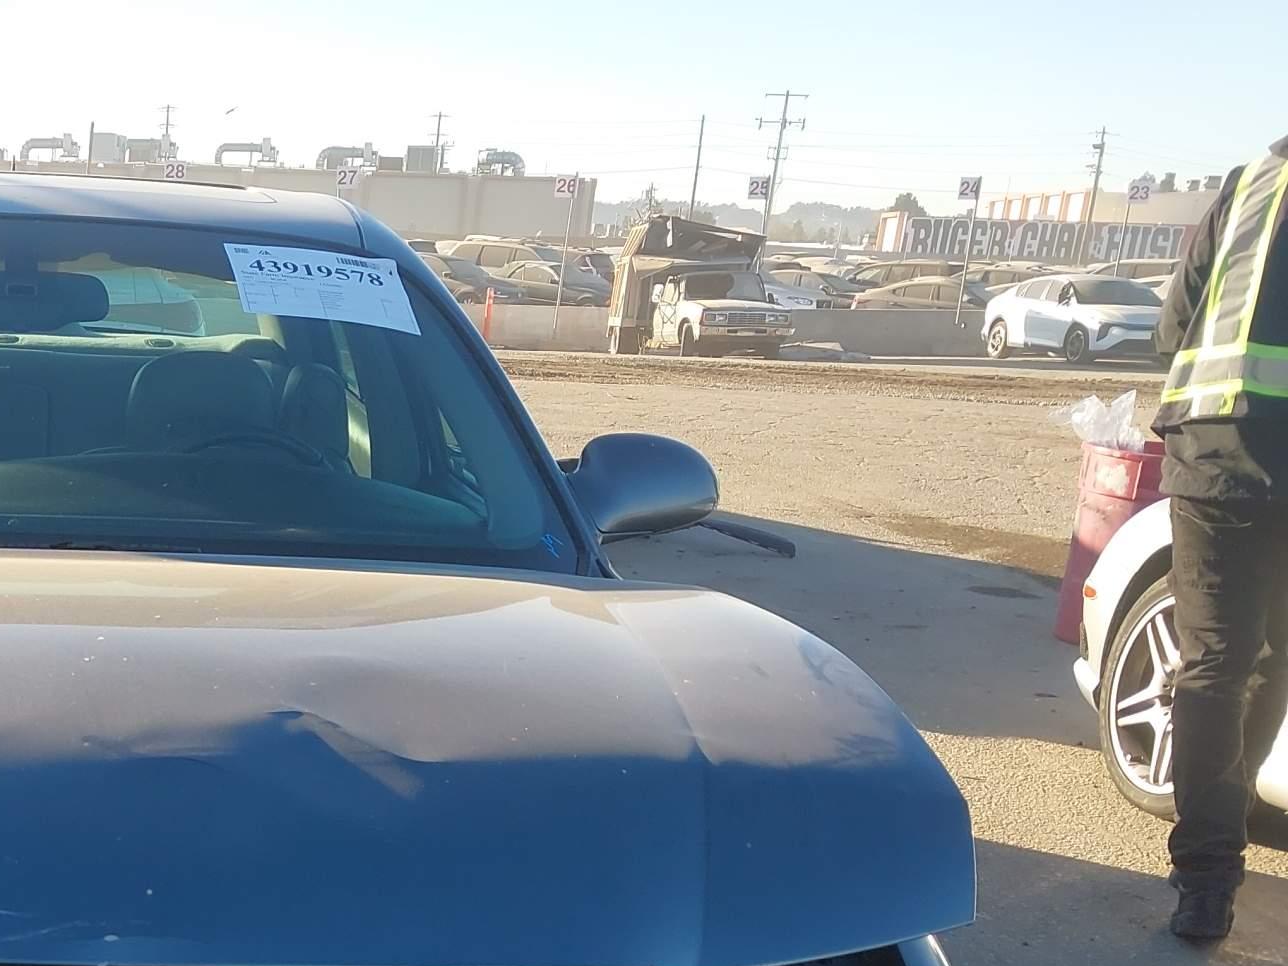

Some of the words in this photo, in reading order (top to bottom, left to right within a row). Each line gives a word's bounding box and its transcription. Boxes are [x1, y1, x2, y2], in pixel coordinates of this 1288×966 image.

[165, 163, 185, 179] 28
[337, 169, 358, 186] 27
[556, 177, 576, 193] 26
[749, 180, 769, 196] 25
[959, 179, 979, 197] 24
[1128, 184, 1150, 200] 23
[248, 258, 385, 287] 43919578
